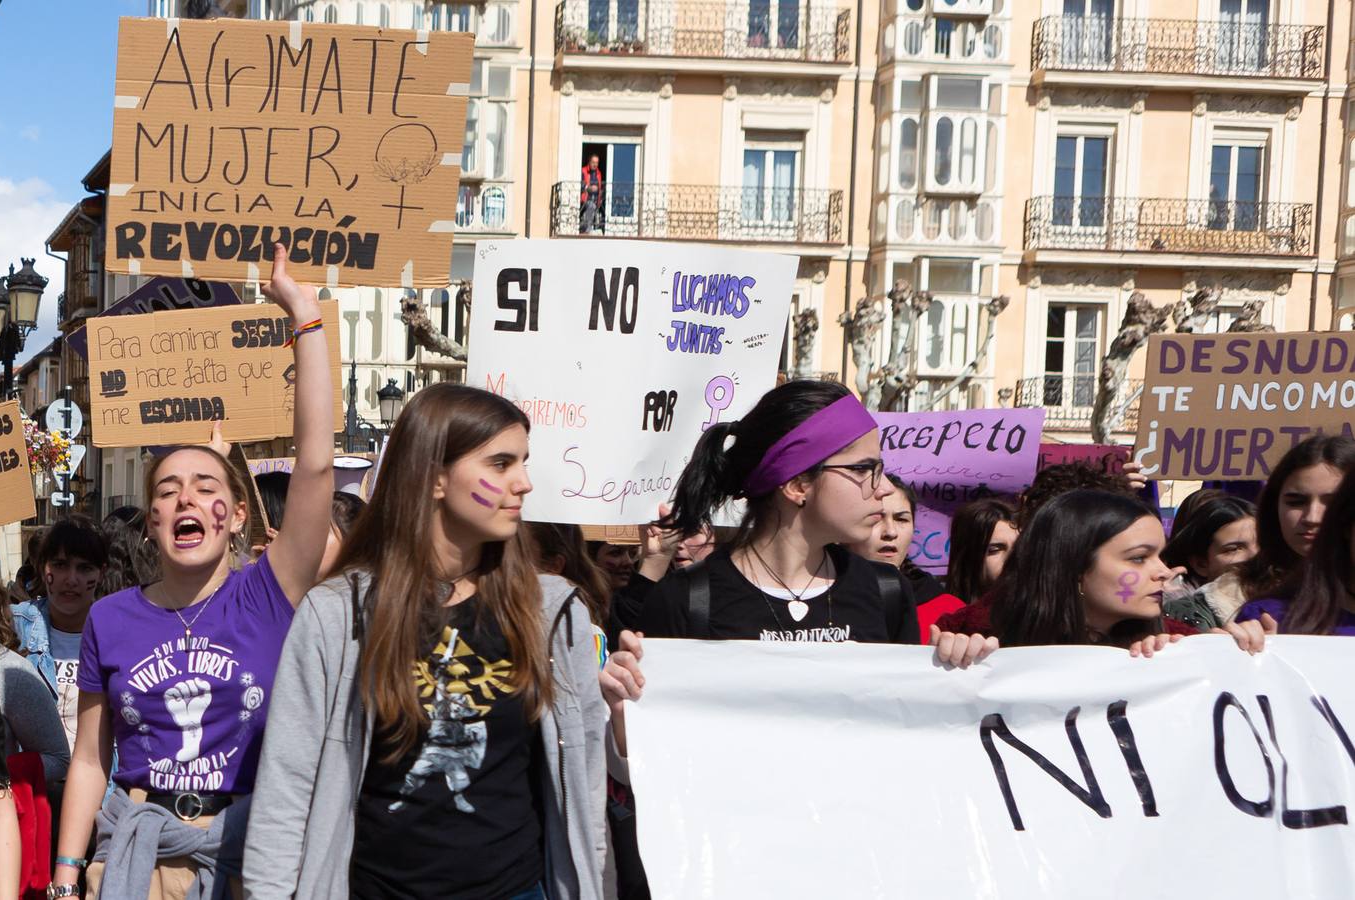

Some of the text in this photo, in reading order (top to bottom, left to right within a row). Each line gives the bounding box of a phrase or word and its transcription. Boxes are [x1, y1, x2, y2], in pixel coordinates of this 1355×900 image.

[134, 122, 358, 191] MUJER,
[295, 196, 334, 219] LA
[115, 215, 379, 270] REVOLUCIÓN
[494, 266, 640, 335] SI NO
[672, 271, 757, 320] LUCHAMOS
[97, 317, 295, 361] Para caminar SEGU
[666, 320, 726, 355] JUNTAS
[100, 358, 273, 397] NO hace falta que
[1151, 386, 1194, 412] TE
[102, 396, 230, 426] me ESCONDA.
[641, 389, 679, 433] POR
[1134, 420, 1325, 477] ¿MUERT
[188, 651, 239, 682] LIBRES
[980, 700, 1159, 831] NI
